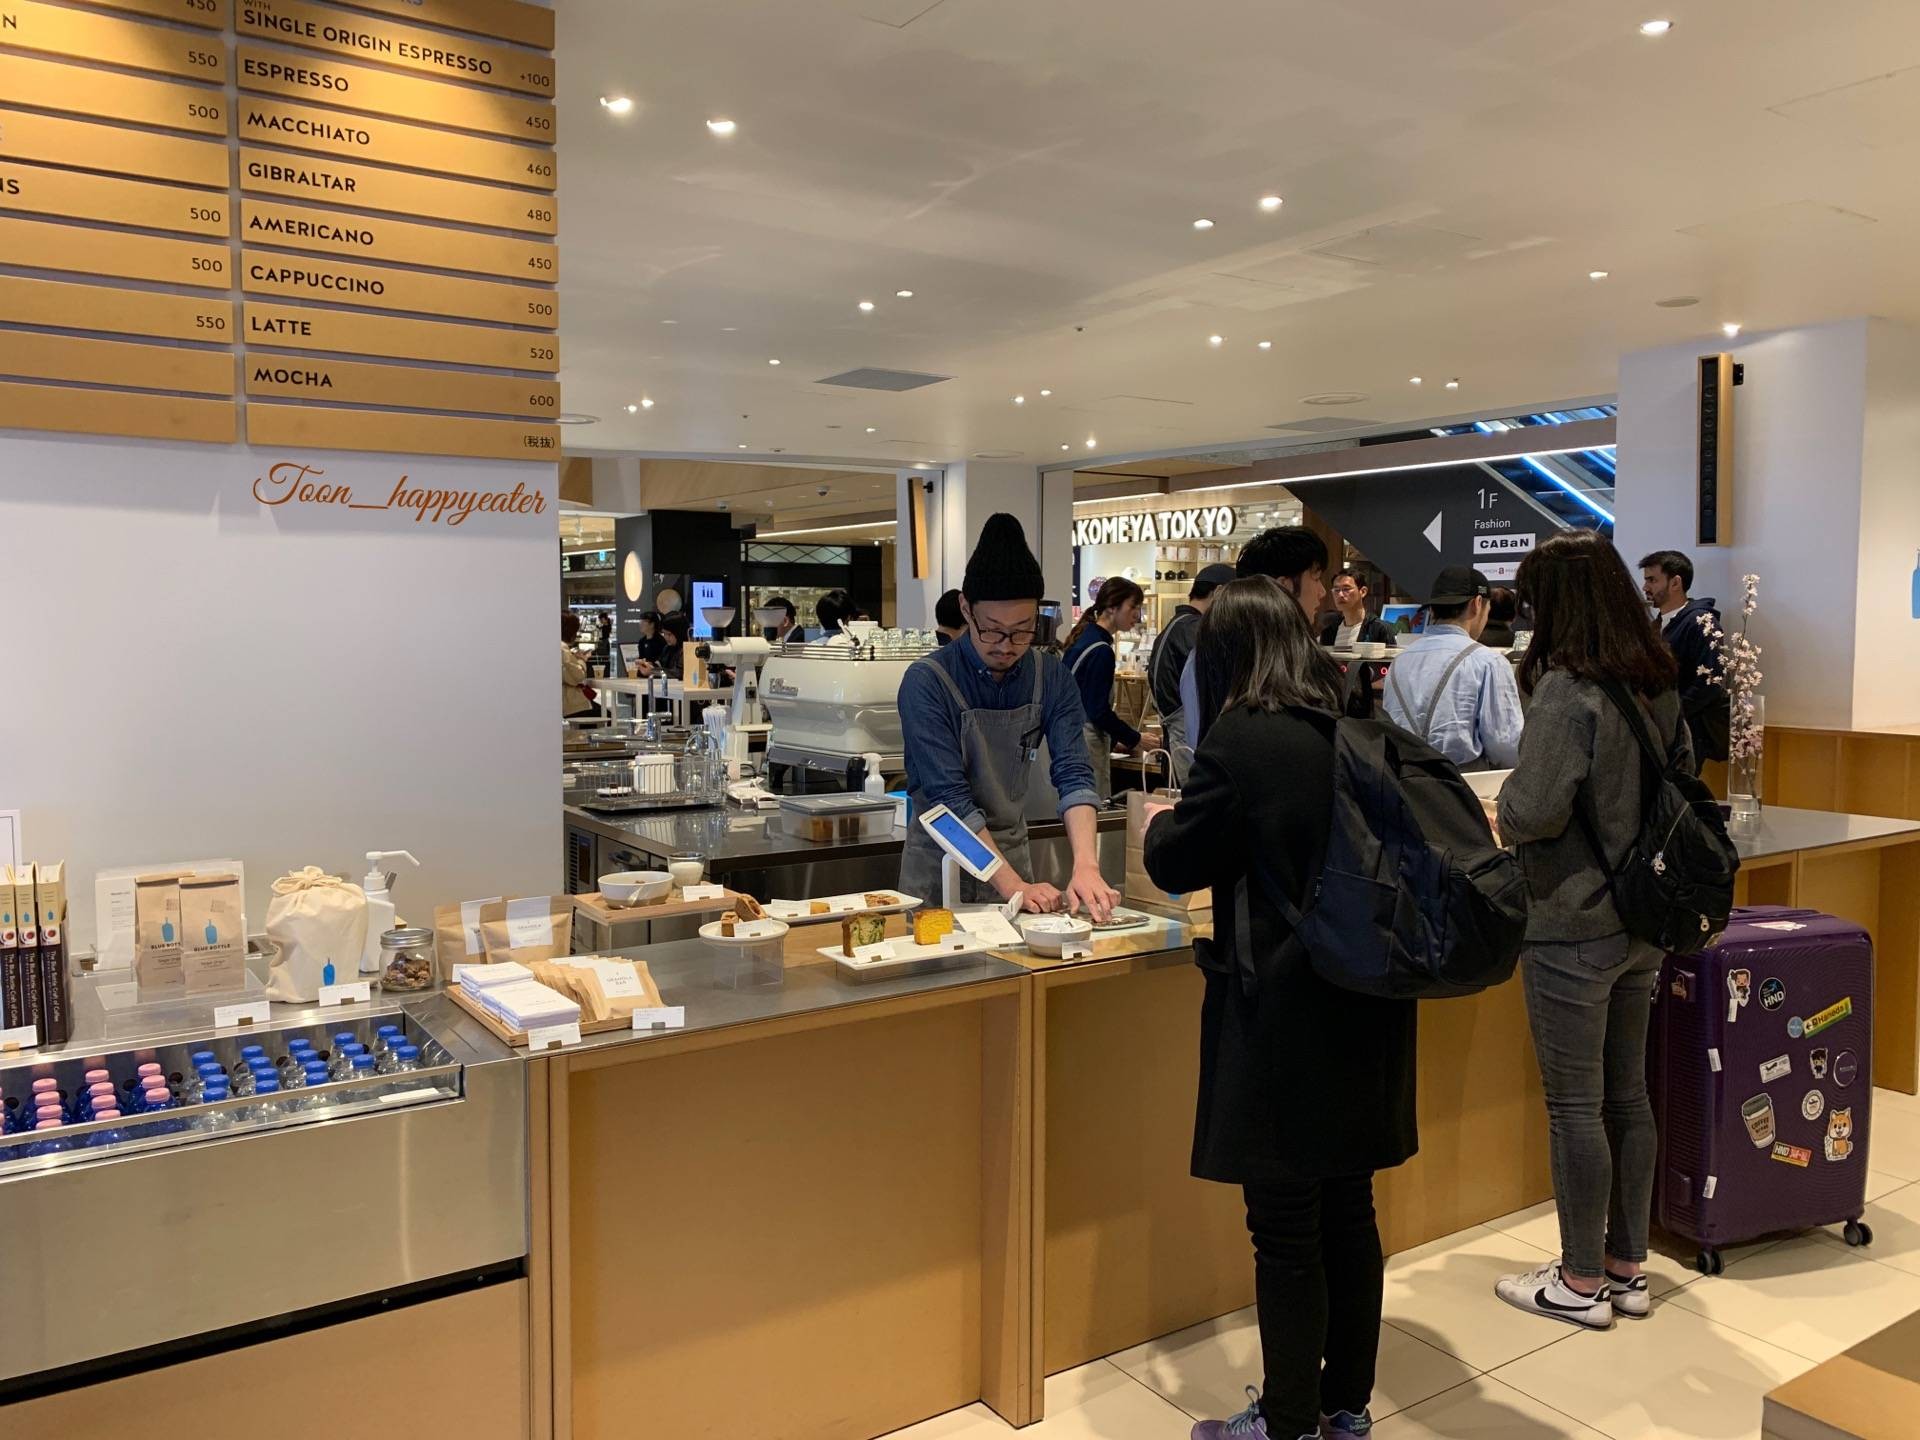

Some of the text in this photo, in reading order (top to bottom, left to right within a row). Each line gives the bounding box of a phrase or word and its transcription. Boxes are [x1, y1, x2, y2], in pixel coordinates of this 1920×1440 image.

[244, 10, 550, 87] SINGLE ORIGIN ESPRESSO +100
[188, 51, 218, 67] 550
[244, 60, 349, 91] ESPRESSO
[188, 104, 219, 120] 500
[247, 112, 370, 145] MACCHIATO
[525, 116, 550, 130] 450
[248, 162, 356, 192] GIBRALTAR
[526, 163, 551, 177] 460
[190, 207, 221, 223] 500
[527, 209, 552, 222] 480
[250, 215, 374, 245] AMERICANO
[192, 257, 223, 272] 500
[528, 257, 552, 270] 450
[250, 265, 385, 295] CAPPUCCINO
[528, 303, 553, 316] 500
[196, 315, 225, 330] 550
[252, 316, 311, 336] LATTE
[530, 347, 554, 360] 520
[254, 368, 333, 388] MOCHA
[529, 395, 554, 407] 600
[1477, 488, 1498, 509] 1F
[1159, 506, 1233, 539] TOKYO
[1474, 519, 1511, 530] Fashion
[1480, 538, 1529, 549] CABaN
[1764, 990, 1785, 1007] HND
